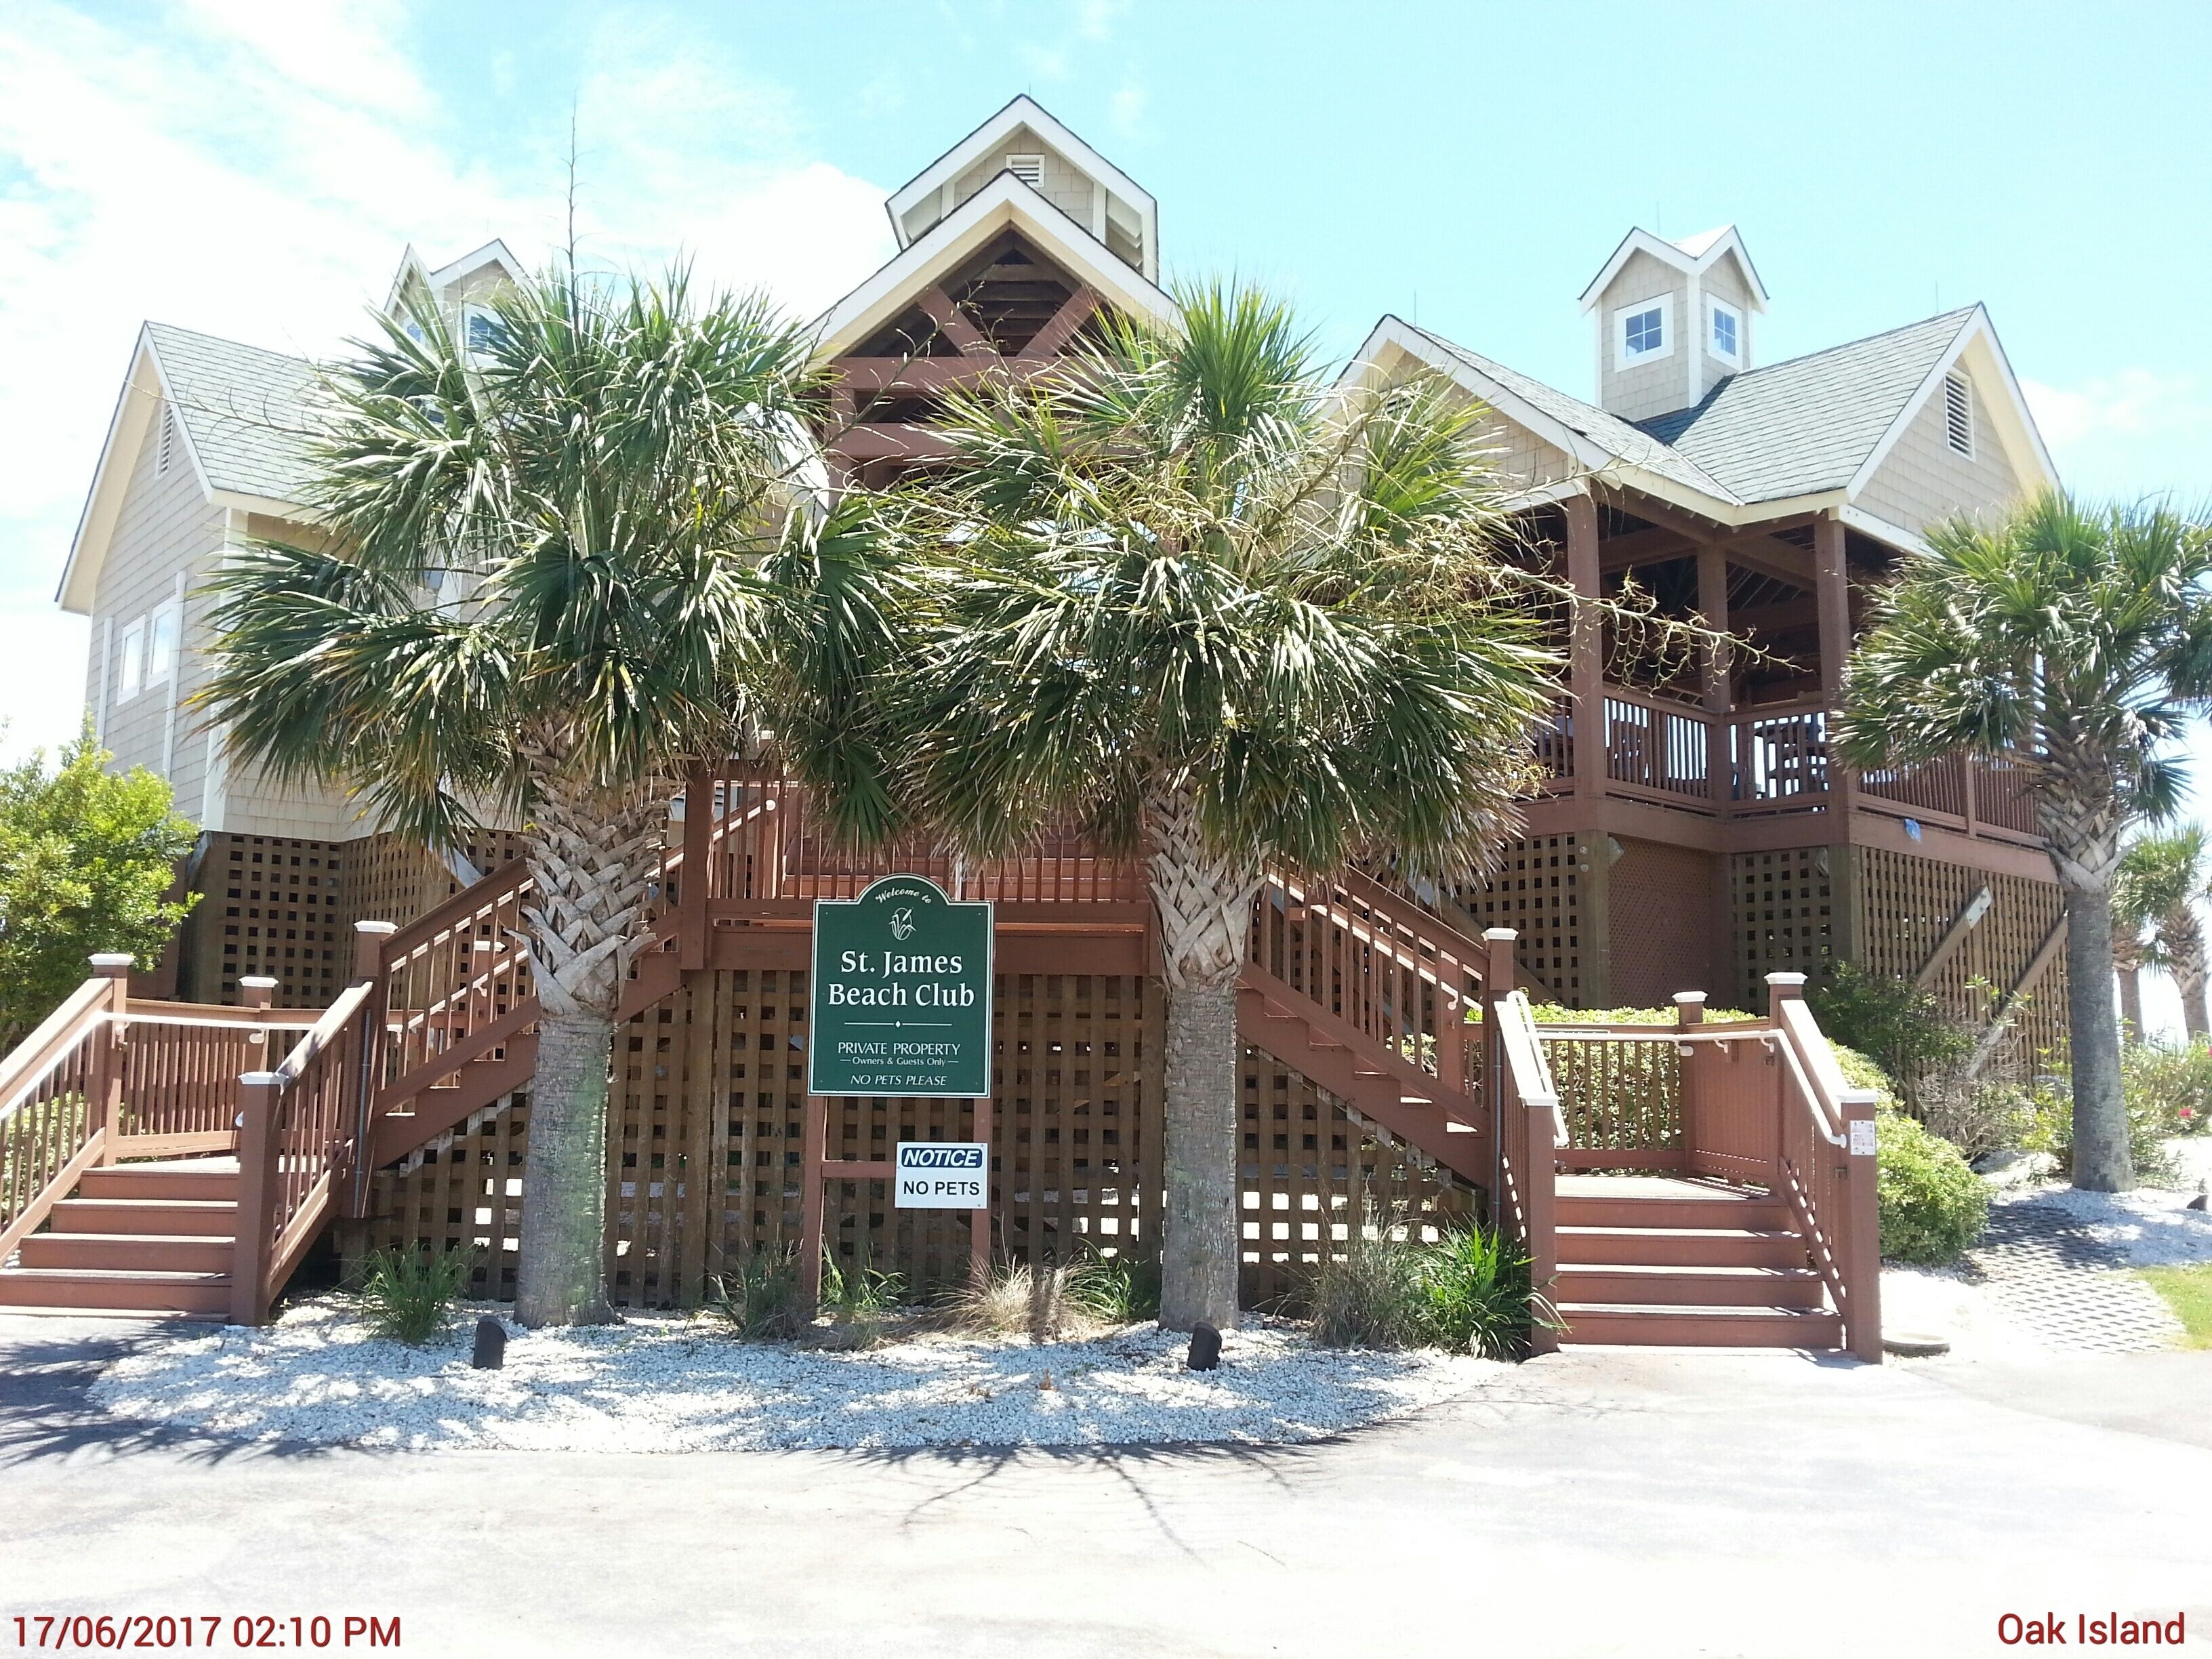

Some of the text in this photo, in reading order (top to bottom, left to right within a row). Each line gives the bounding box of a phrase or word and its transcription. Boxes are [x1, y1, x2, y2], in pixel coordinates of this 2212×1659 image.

[875, 887, 932, 903] Welcome to
[840, 950, 962, 979] St. James
[828, 982, 975, 1007] Beach Club
[838, 1042, 961, 1055] PRIVATE PROPERTY
[852, 1057, 884, 1065] Owners
[897, 1057, 924, 1065] Guests
[926, 1057, 945, 1067] Only
[851, 1074, 947, 1086] NO PETS PLEASE
[903, 1149, 979, 1166] NOTICE
[903, 1181, 980, 1195] NO PETS
